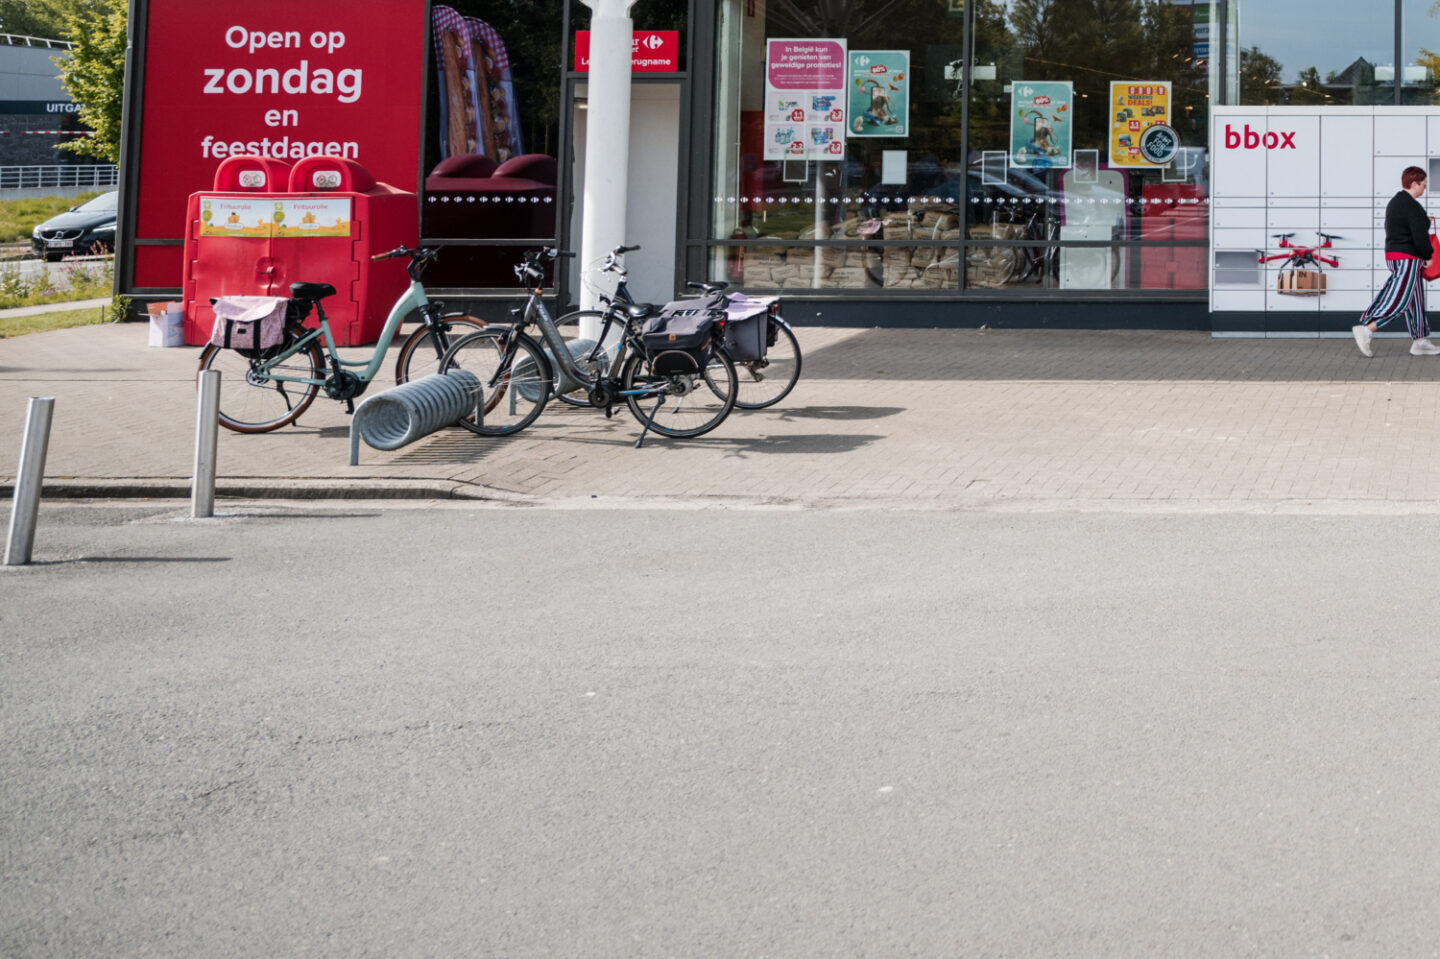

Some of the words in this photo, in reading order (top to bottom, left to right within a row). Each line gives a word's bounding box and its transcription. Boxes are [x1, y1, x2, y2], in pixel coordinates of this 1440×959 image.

[225, 25, 301, 54] Open
[309, 31, 346, 54] op
[630, 57, 671, 67] erugname
[771, 61, 805, 70] geweldige
[203, 59, 363, 104] zondag
[46, 103, 87, 113] UITGA
[264, 109, 298, 127] en
[201, 135, 359, 159] feestdagen
[1224, 124, 1297, 150] bbox
